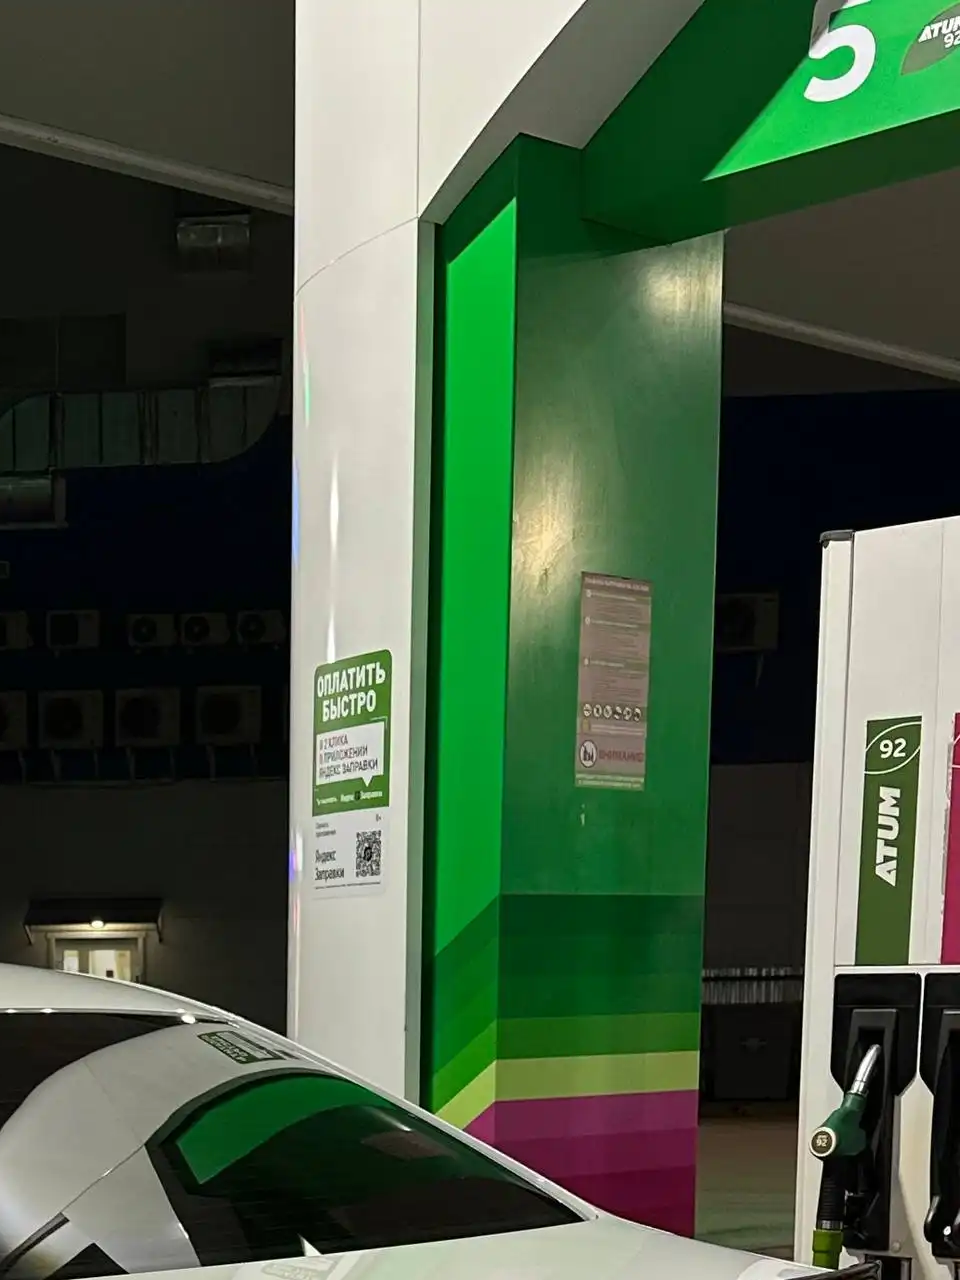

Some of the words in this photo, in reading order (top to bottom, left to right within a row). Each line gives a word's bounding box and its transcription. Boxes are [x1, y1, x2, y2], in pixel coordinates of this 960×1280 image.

[804, 0, 876, 102] 5
[317, 662, 386, 698] ОПЛАТИТЬ
[322, 689, 377, 722] БЫСТРО
[324, 744, 368, 763] ПРИЛОЖЕНИИ
[879, 738, 907, 758] 92
[342, 758, 379, 774] ЗАПРАВКИ
[875, 786, 901, 887] ATUM
[315, 867, 345, 883] Заправки
[816, 1138, 827, 1147] 92
